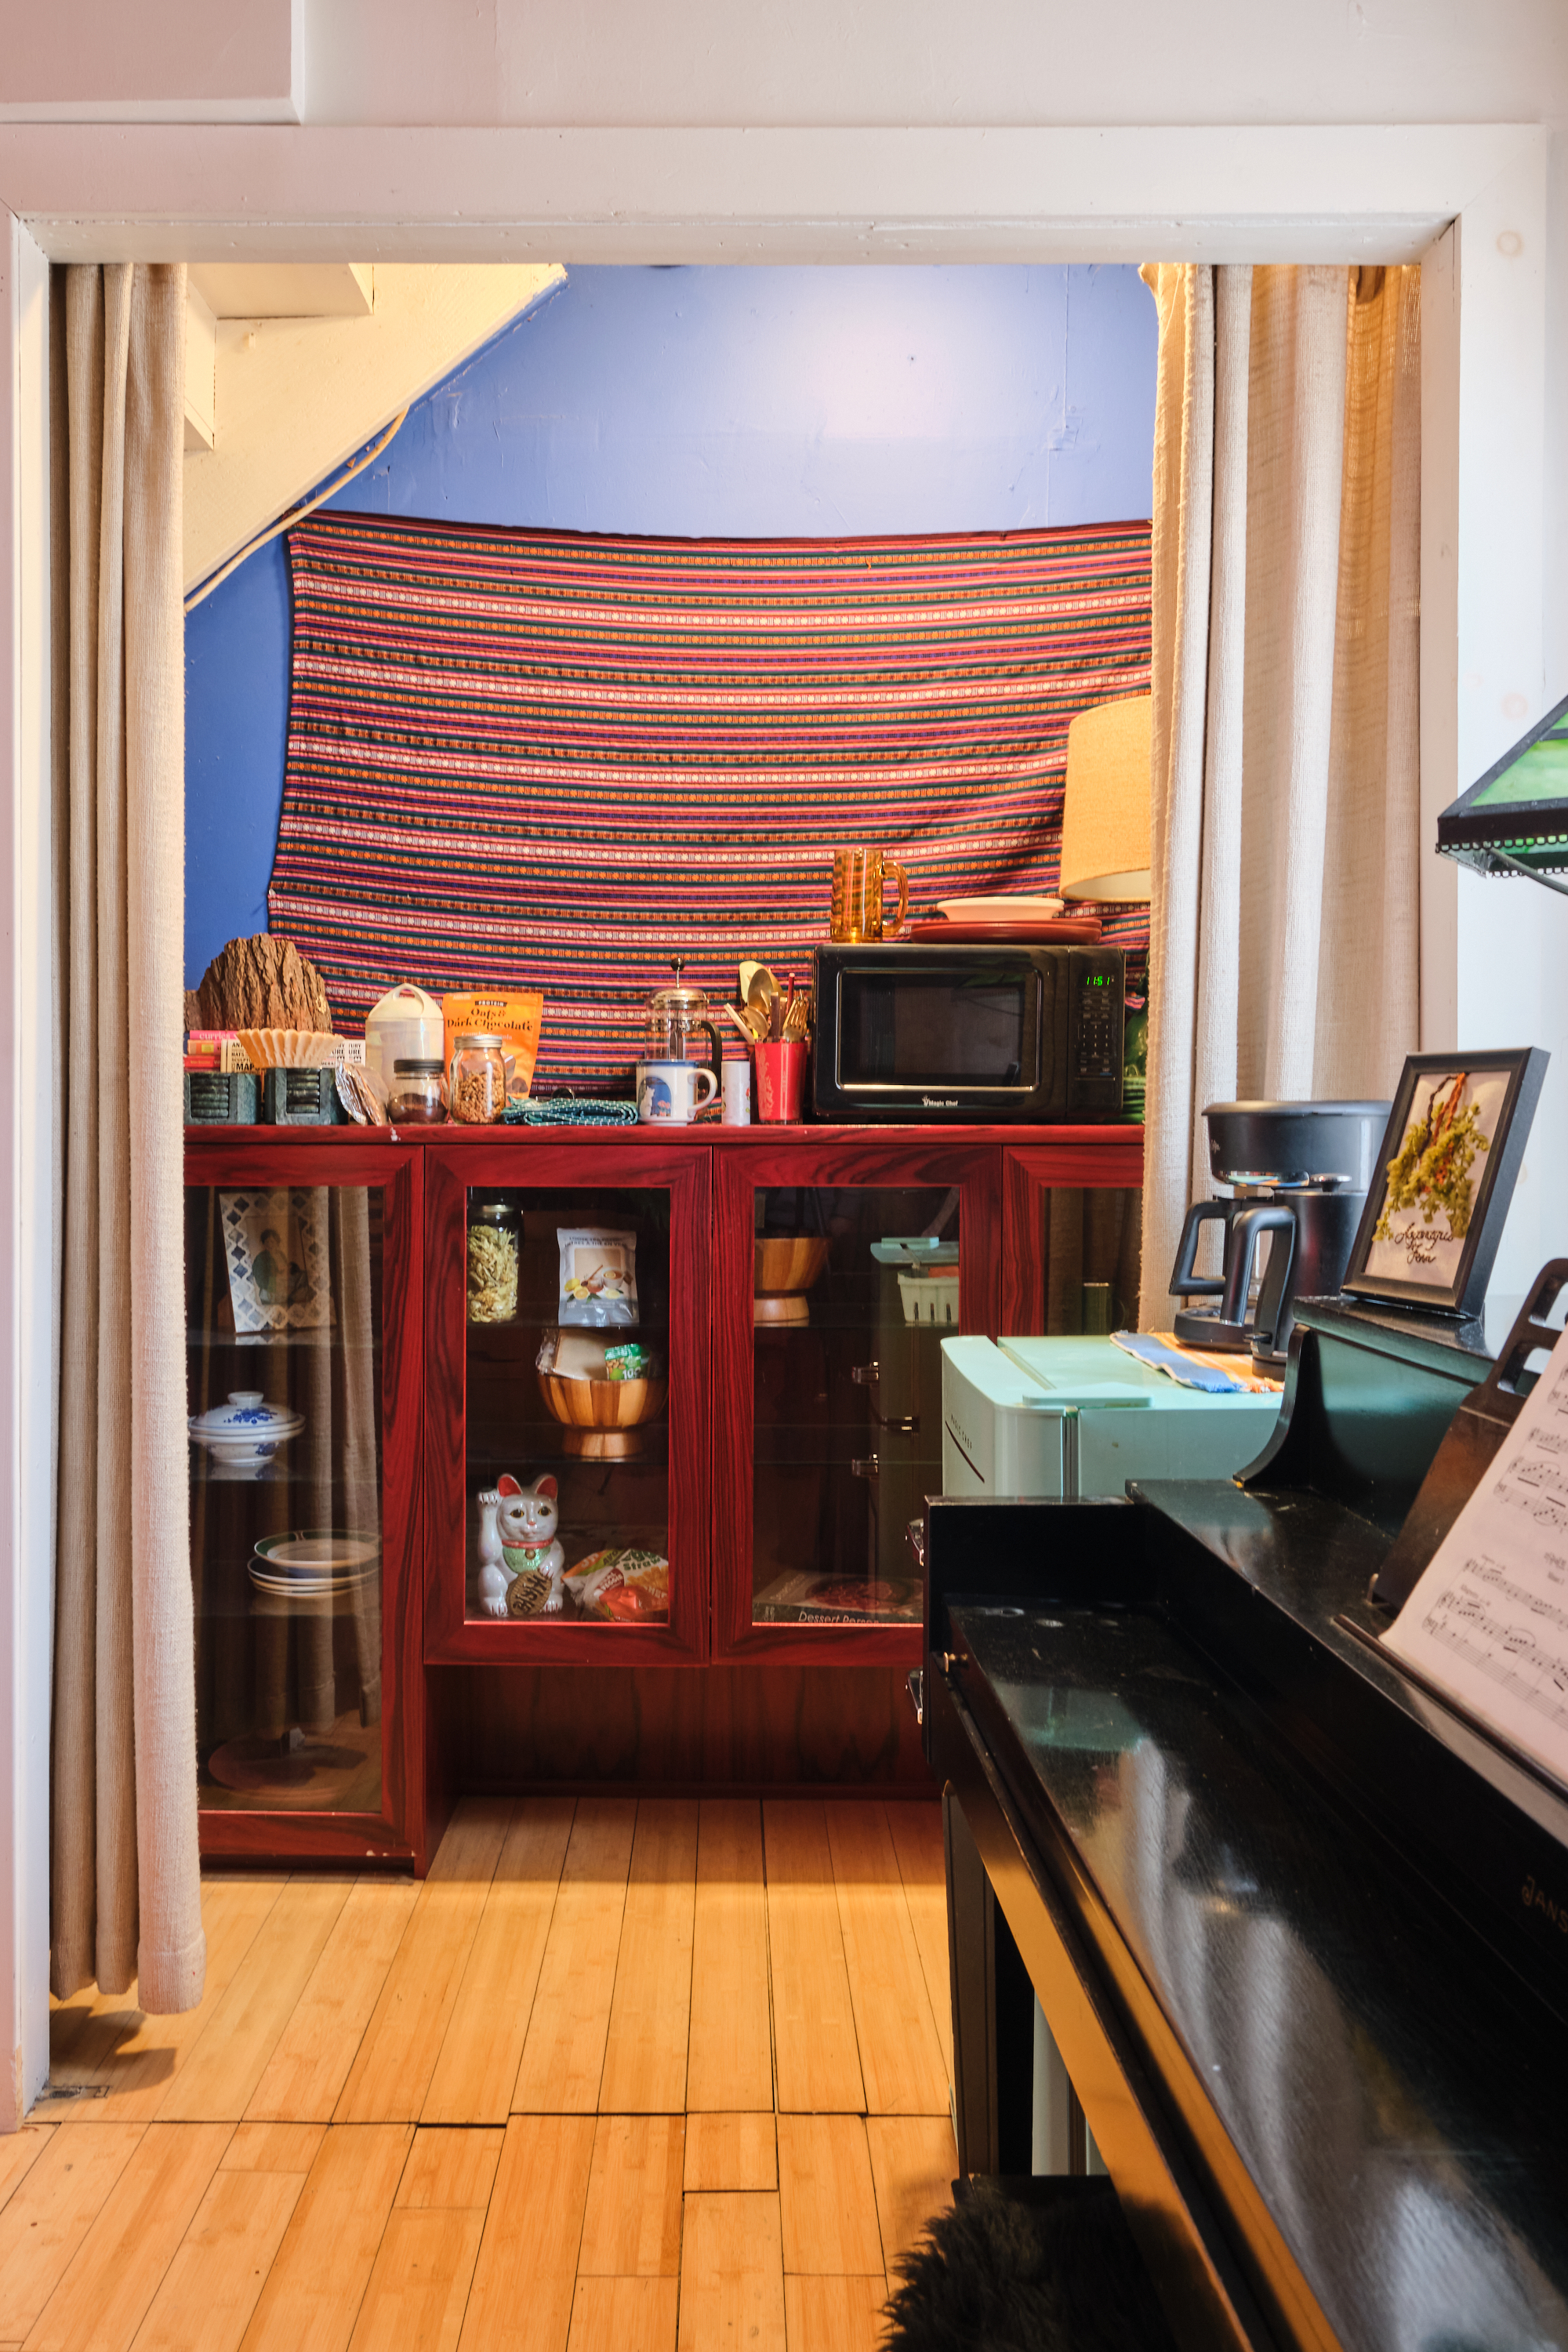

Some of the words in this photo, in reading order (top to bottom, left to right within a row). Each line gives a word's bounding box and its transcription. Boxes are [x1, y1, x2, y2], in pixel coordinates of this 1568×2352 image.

[1087, 976, 1110, 986] 11:51
[470, 1007, 496, 1020] Oats
[498, 1009, 506, 1018] &
[447, 1017, 471, 1028] Dark
[474, 1018, 533, 1031] Chocolate
[798, 1610, 840, 1623] Dessert
